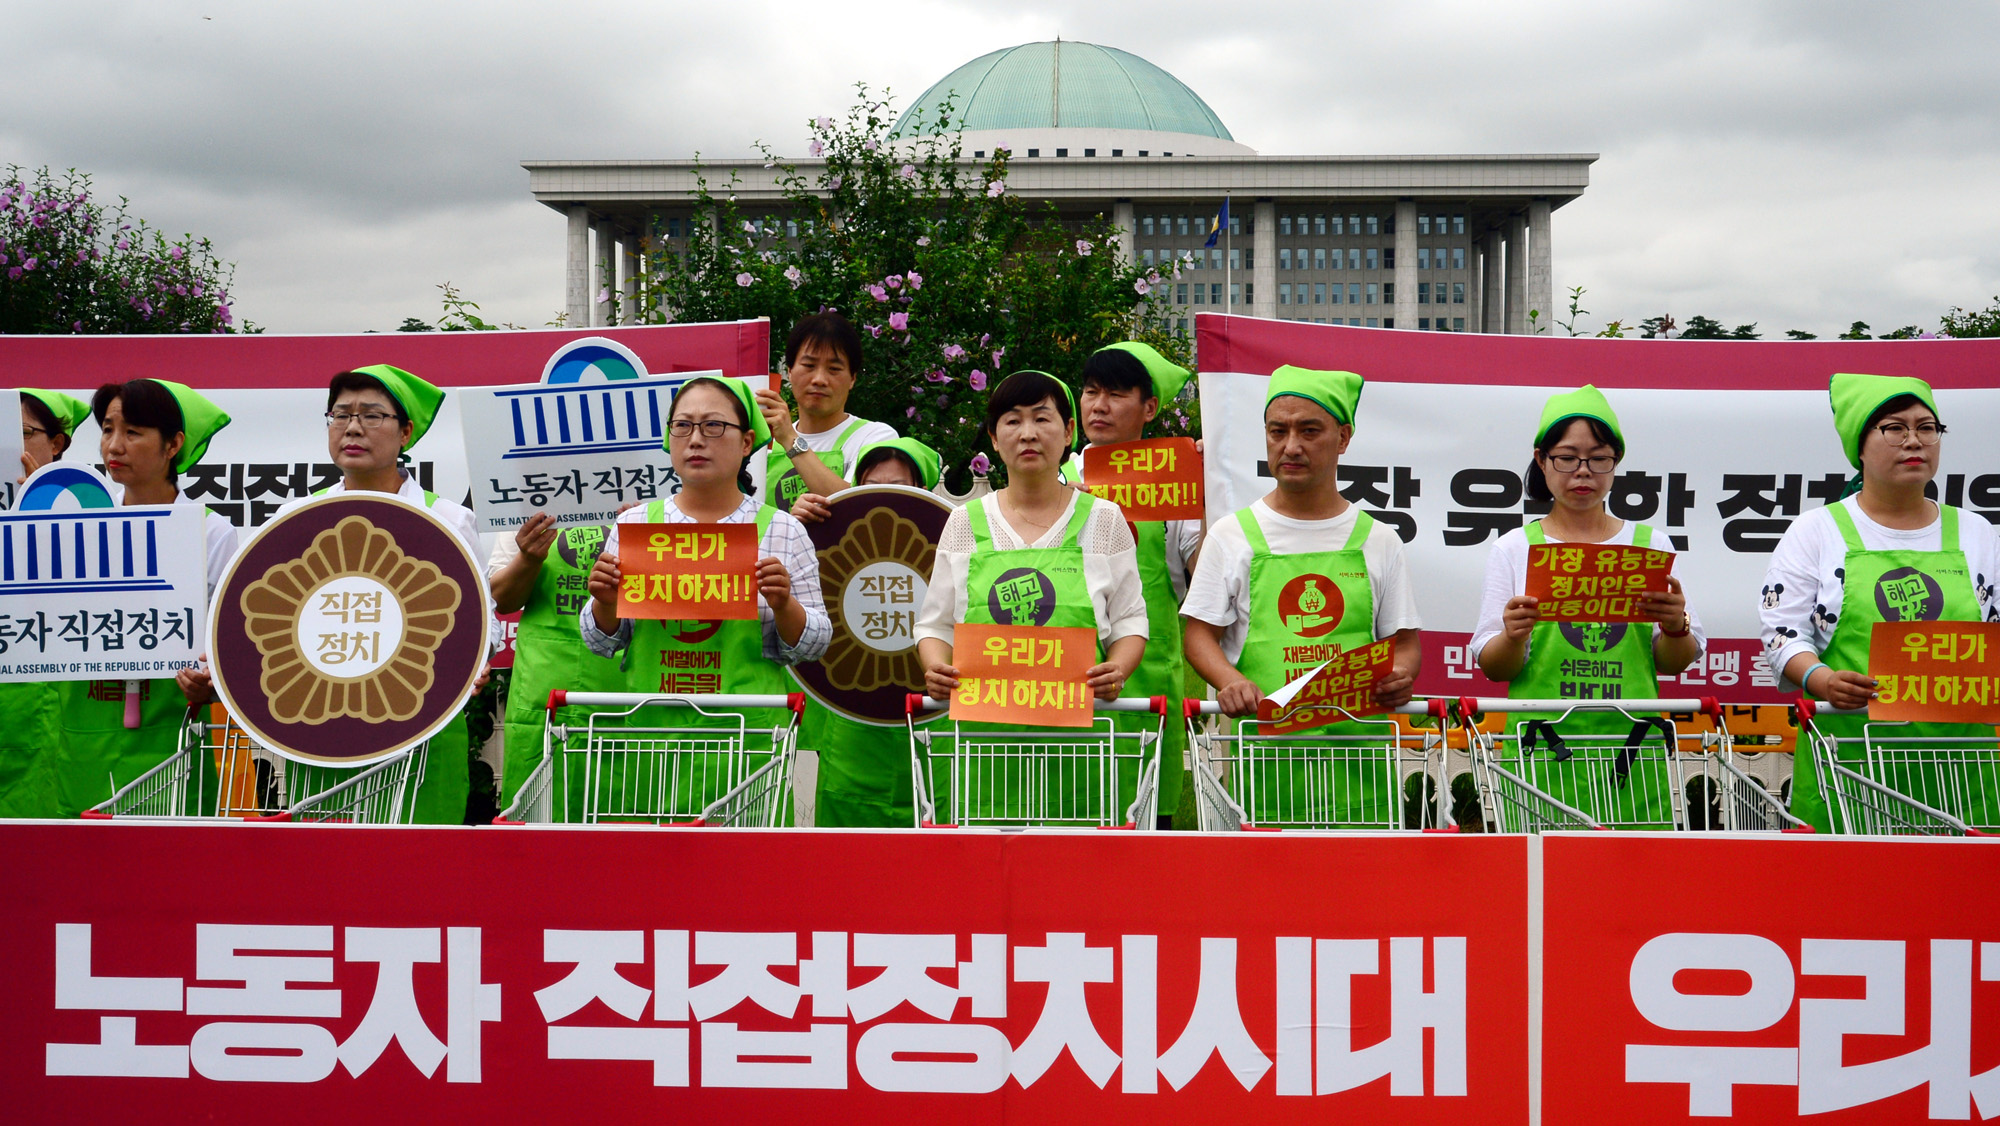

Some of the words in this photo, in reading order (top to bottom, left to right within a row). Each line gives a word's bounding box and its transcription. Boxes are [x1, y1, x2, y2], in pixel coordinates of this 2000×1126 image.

[1108, 447, 1177, 474] 우리가
[488, 469, 589, 508] 노동자
[593, 464, 683, 502] 직접정
[489, 518, 506, 527] THE
[556, 512, 605, 523] ASSEMBLY
[1442, 468, 1695, 552] 유한
[646, 532, 728, 562] 우리가
[1533, 547, 1585, 573] 가장
[1595, 549, 1670, 573] 유능한
[622, 573, 751, 603] 정치하자!!
[859, 574, 914, 605] 직접
[1000, 577, 1040, 603] 해고
[1305, 590, 1319, 598] TAX
[1550, 574, 1648, 599] 정치인은
[1887, 578, 1926, 602] 해고
[319, 591, 383, 624] 직접
[58, 607, 195, 653] 직접정치
[861, 610, 915, 640] 정치
[316, 631, 381, 665] 정치
[660, 650, 722, 669] 재벌에게
[983, 637, 1064, 668] 우리가
[1901, 633, 1988, 663] 우리가
[16, 663, 67, 674] ASSEMBLY
[70, 663, 82, 673] OF
[84, 662, 102, 672] THE
[105, 661, 151, 672] REPUBLIC
[153, 660, 166, 671] OF
[168, 660, 200, 671] KOREA
[1560, 659, 1623, 679] 쉬운해고
[956, 677, 1087, 710] 정치하자!!
[45, 922, 502, 1084] 노동자
[533, 928, 1467, 1097] 직접정치시대
